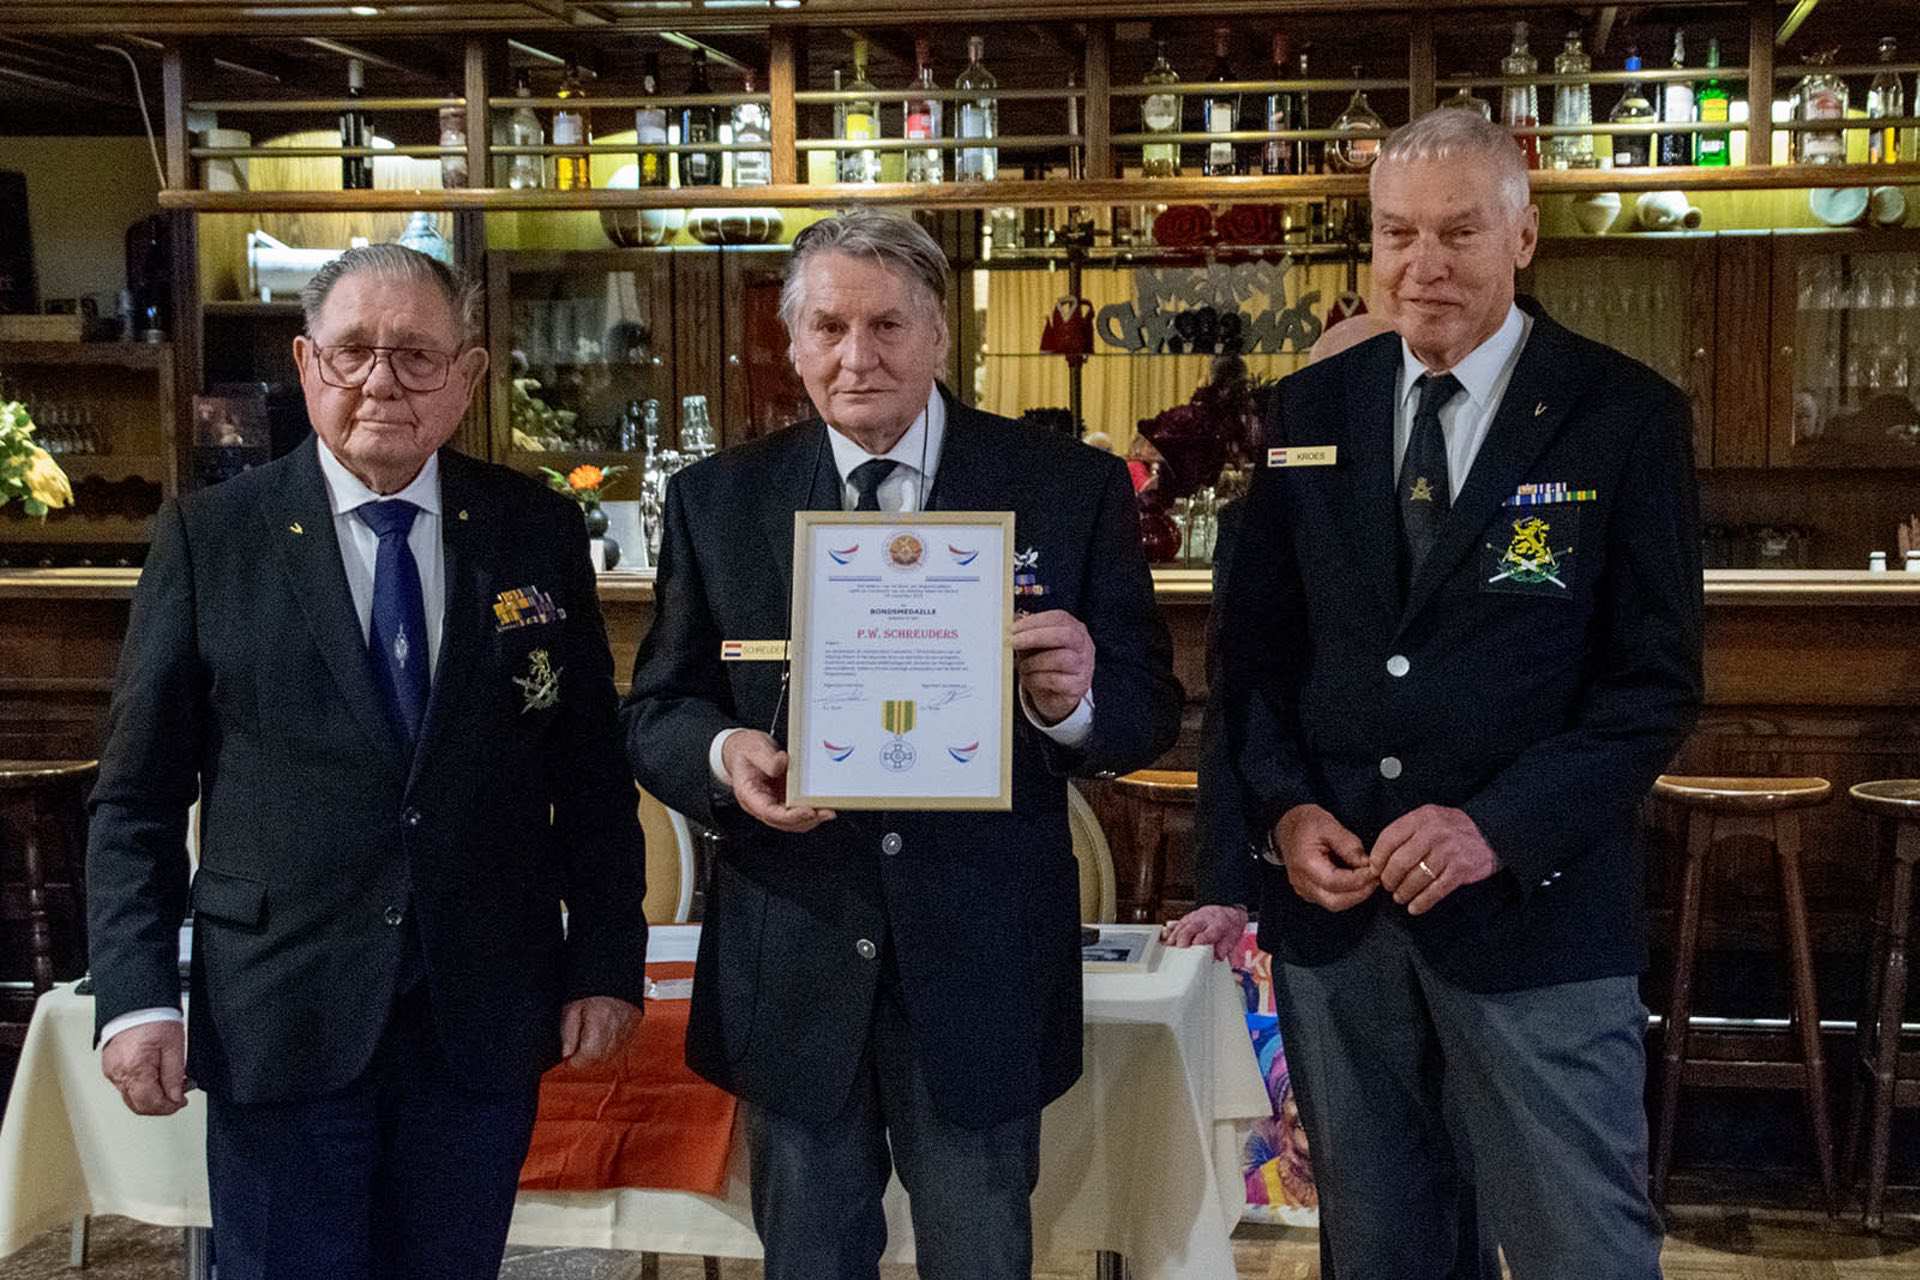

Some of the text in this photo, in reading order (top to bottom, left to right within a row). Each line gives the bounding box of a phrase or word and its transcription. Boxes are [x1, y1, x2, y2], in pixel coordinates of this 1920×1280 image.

[1297, 452, 1326, 461] KROES
[870, 607, 937, 616] BONDSMEDAILLE
[857, 627, 959, 639] P.W. SCHREUDERS
